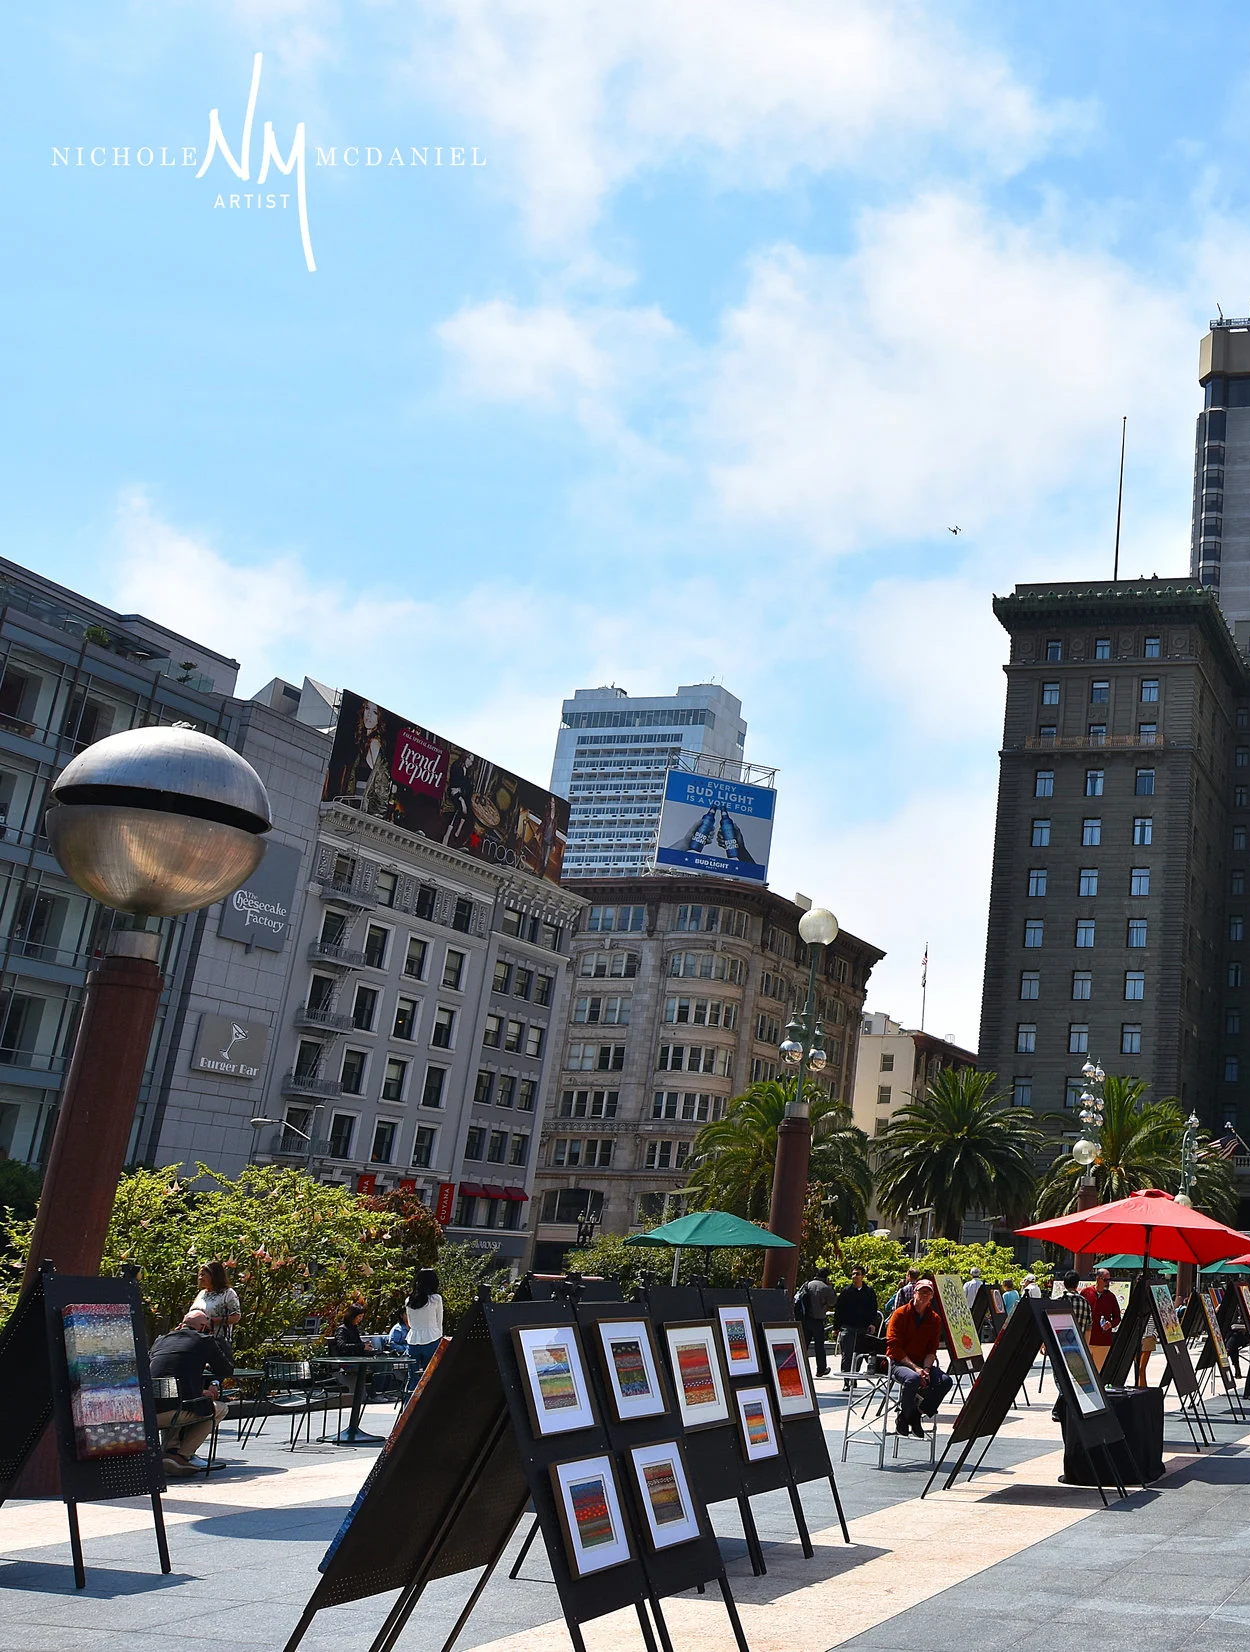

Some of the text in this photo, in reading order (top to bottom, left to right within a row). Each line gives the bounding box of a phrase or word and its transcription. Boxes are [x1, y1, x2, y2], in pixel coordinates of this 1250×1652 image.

[400, 743, 441, 773] trend
[398, 758, 443, 788] report
[687, 784, 754, 805] BUD LIGHT
[707, 781, 737, 792] EVERY
[686, 794, 695, 802] IS
[708, 798, 732, 809] VOTE
[735, 804, 753, 813] FOR
[232, 889, 287, 917] Cheesecake
[248, 891, 258, 900] The
[244, 907, 285, 933] Factory
[200, 1056, 259, 1077] Burger Bar
[440, 1188, 450, 1220] CUYANA
